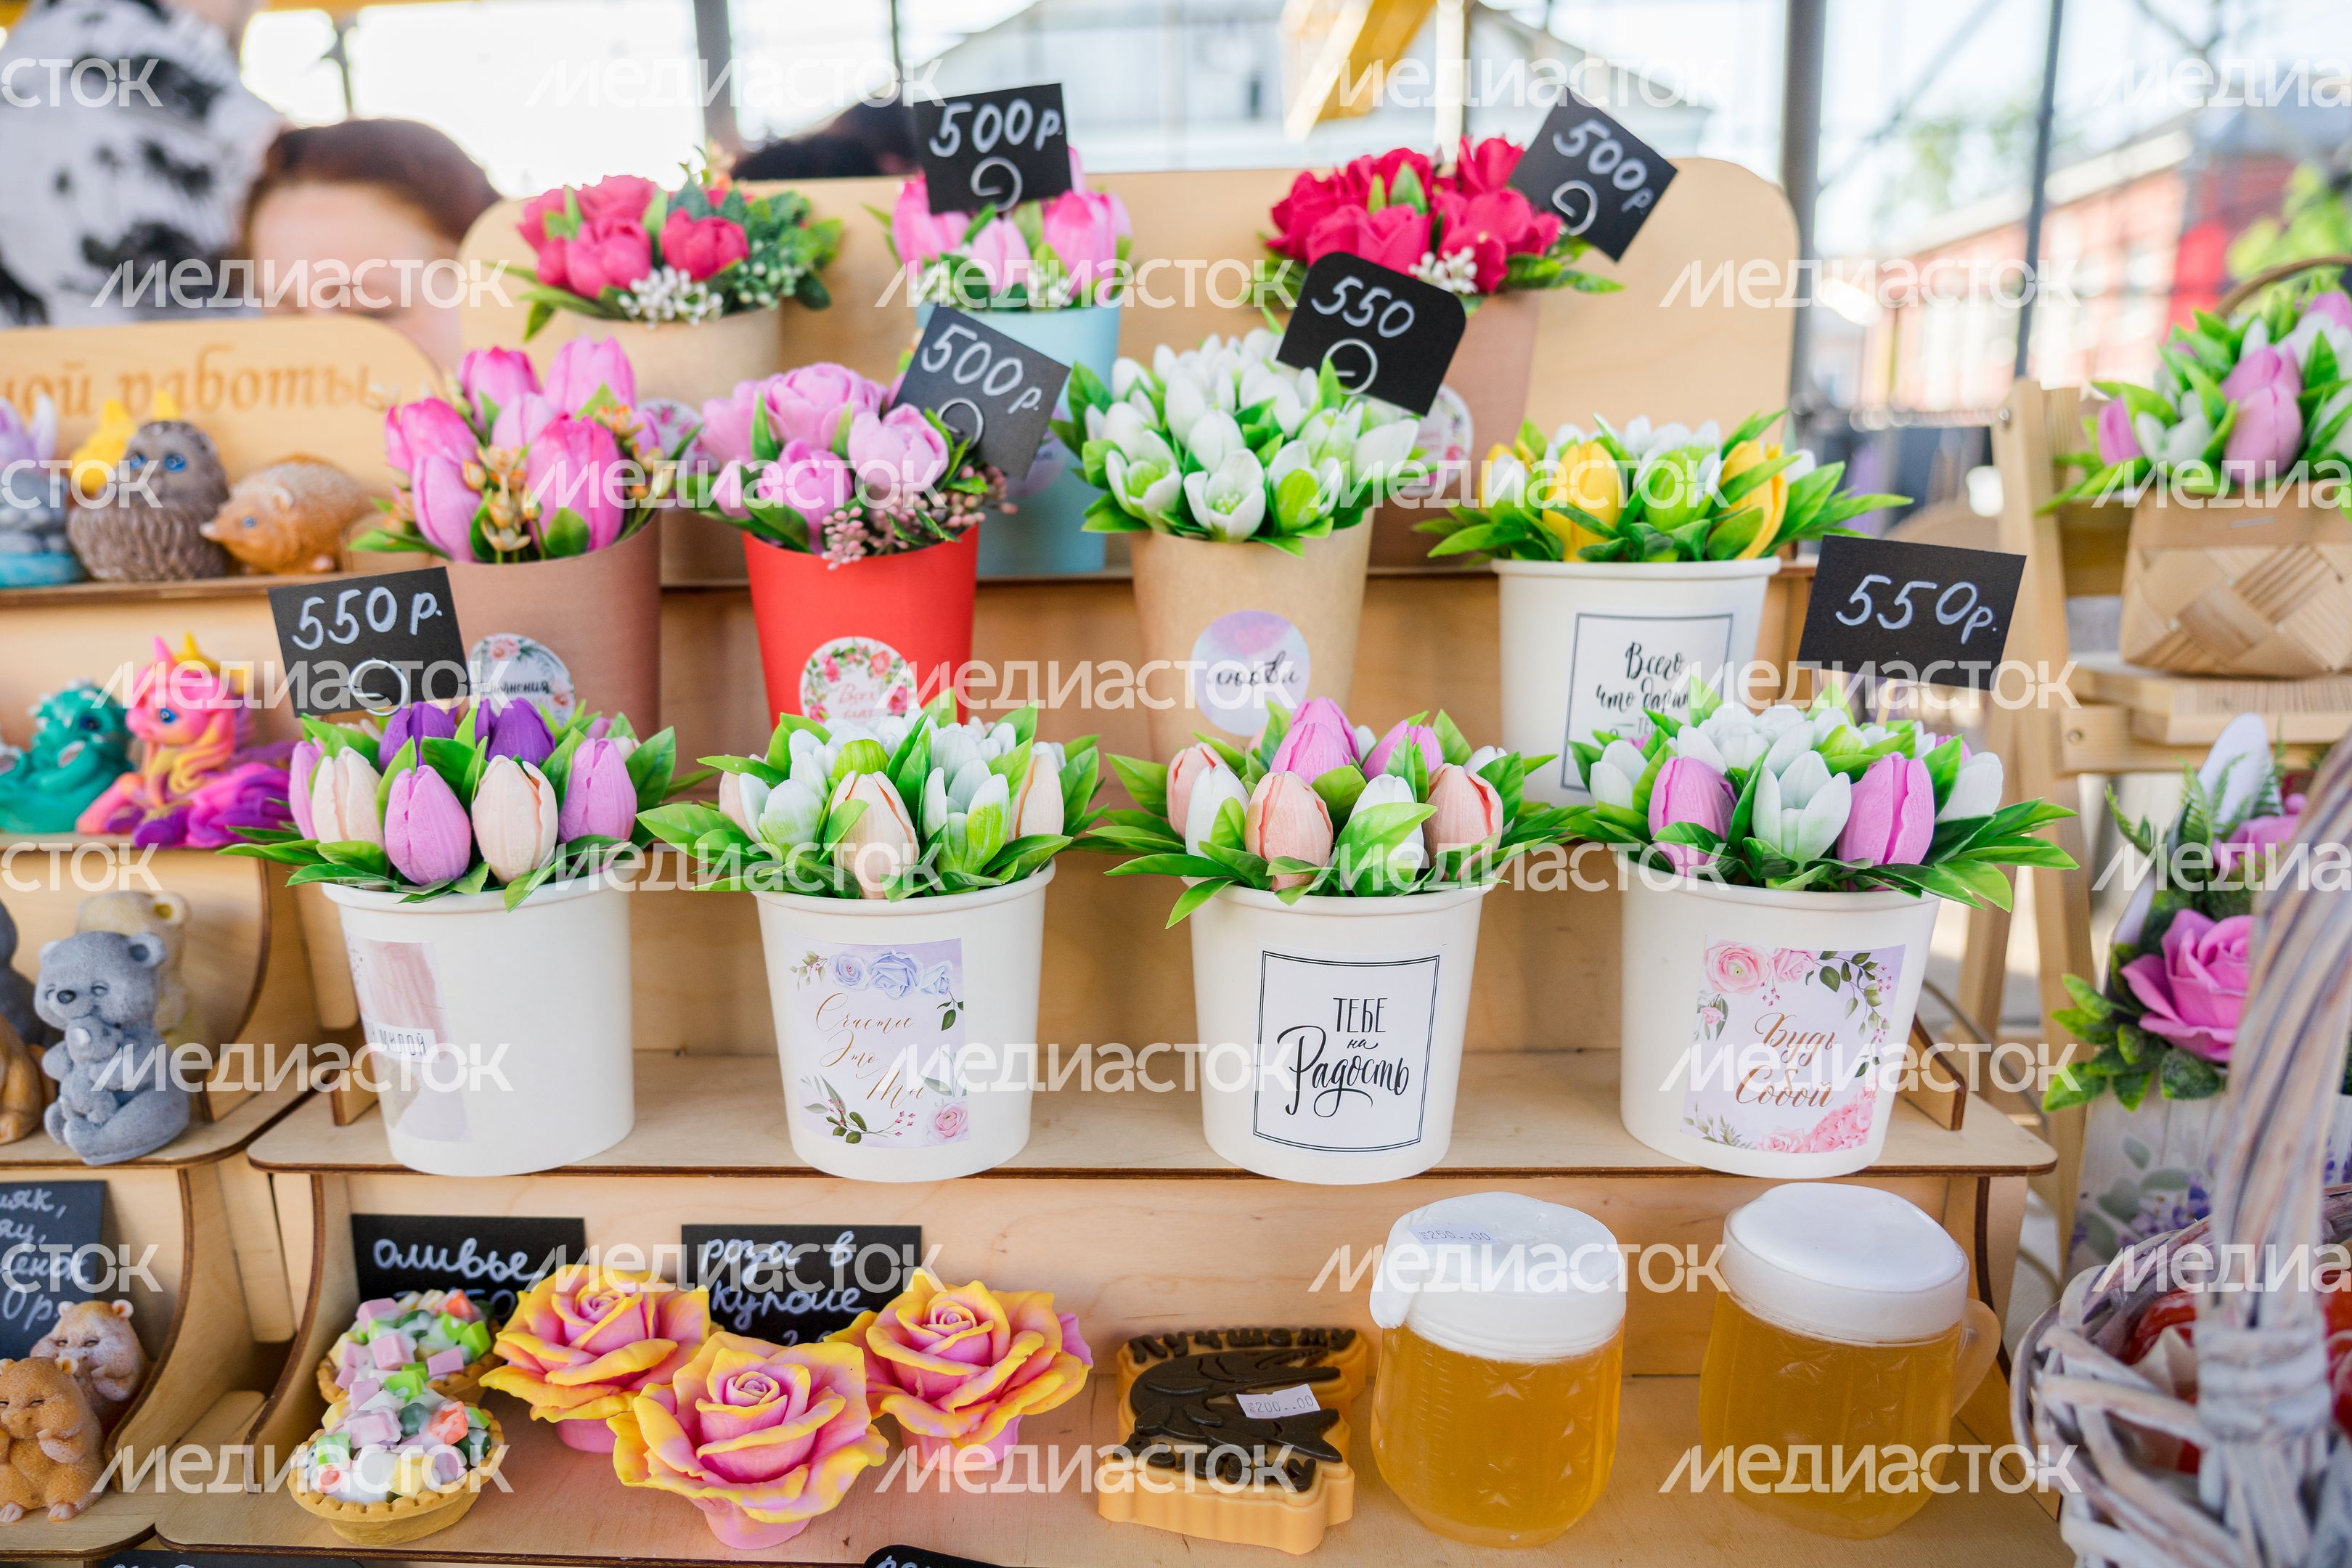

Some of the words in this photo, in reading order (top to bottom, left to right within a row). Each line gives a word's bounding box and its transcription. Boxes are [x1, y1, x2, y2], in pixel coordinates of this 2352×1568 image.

[1311, 276, 1414, 338] 550
[1333, 997, 1388, 1033] ТЕБЕ
[1754, 1012, 1837, 1066] Будь
[1277, 1025, 1410, 1117] Радость
[1347, 1039, 1379, 1050] на
